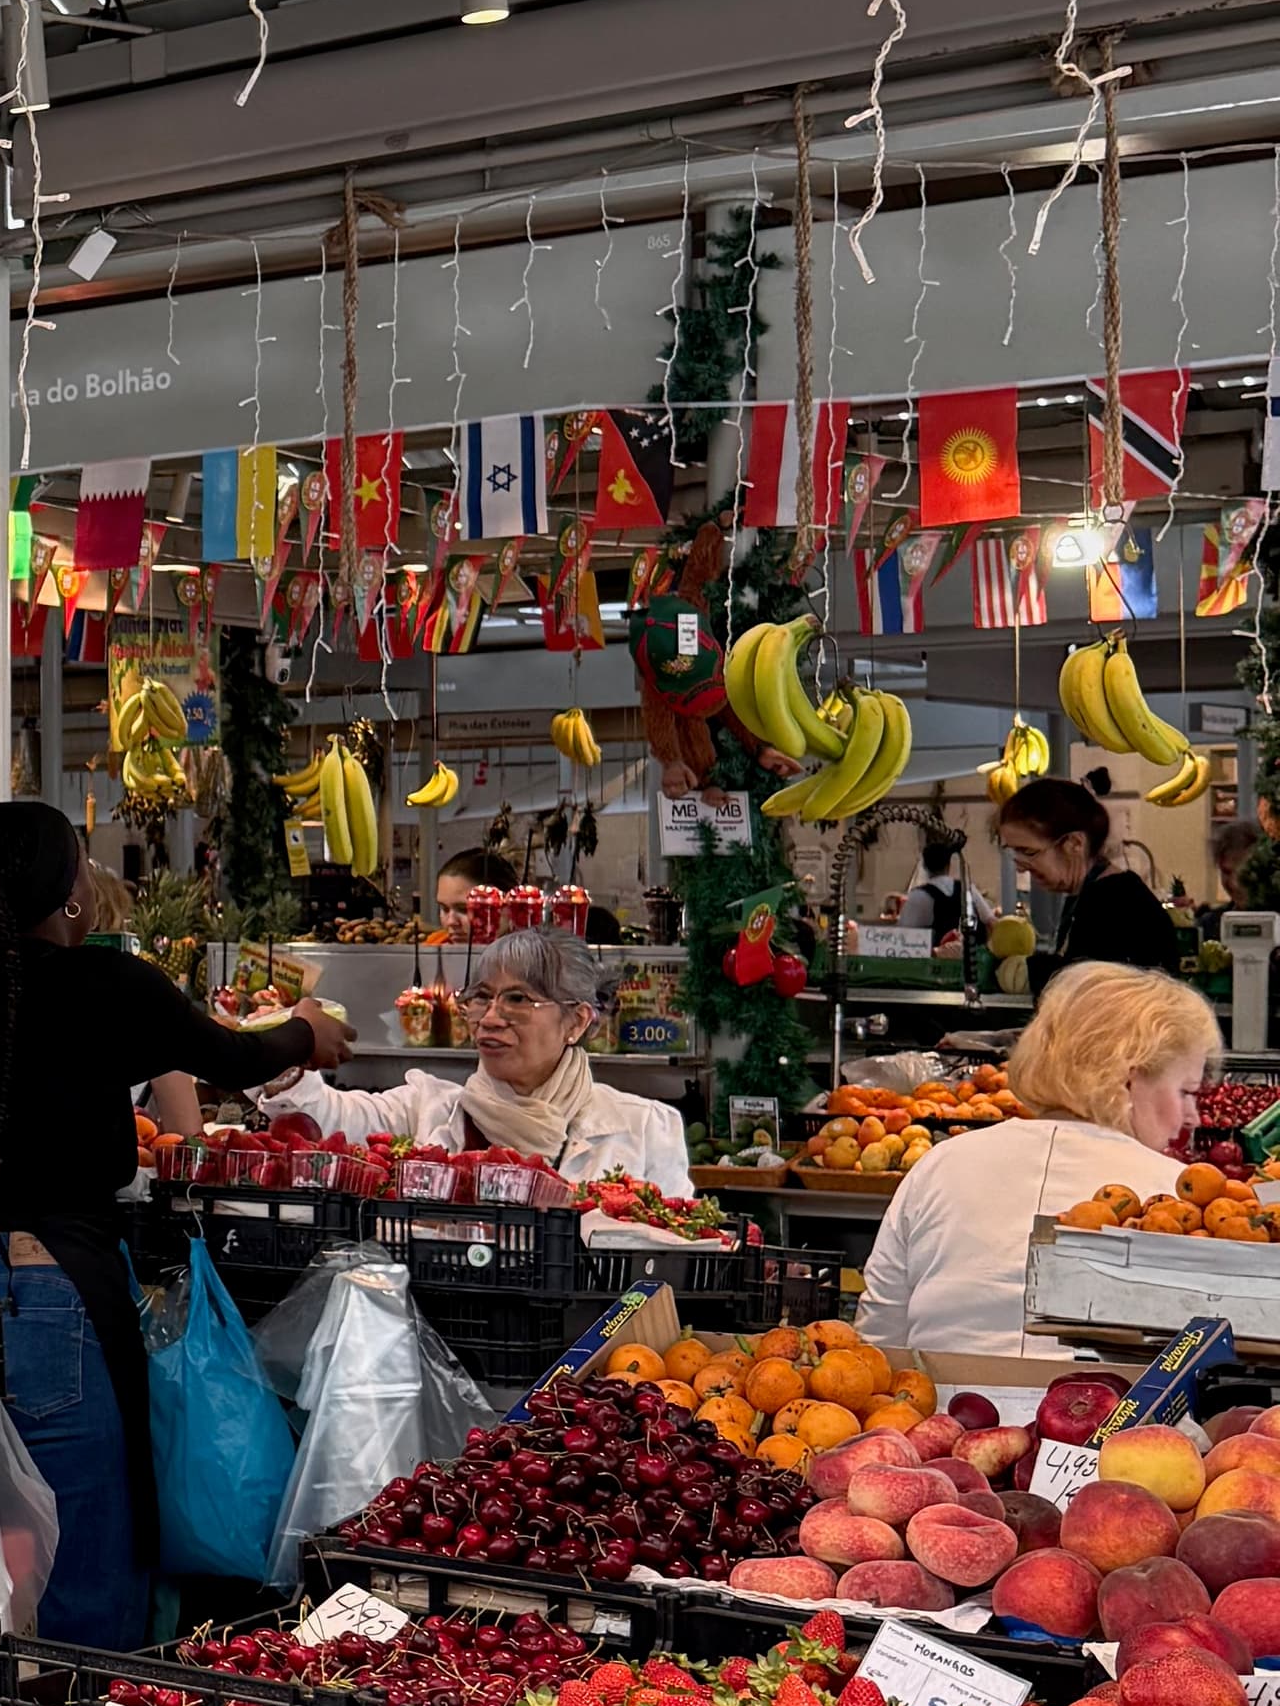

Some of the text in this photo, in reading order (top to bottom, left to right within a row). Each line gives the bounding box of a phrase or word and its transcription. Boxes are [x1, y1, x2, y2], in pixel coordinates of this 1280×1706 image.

[46, 378, 78, 404] do
[85, 367, 171, 399] Bolhão
[672, 804, 698, 818] MB
[715, 804, 742, 818] MB
